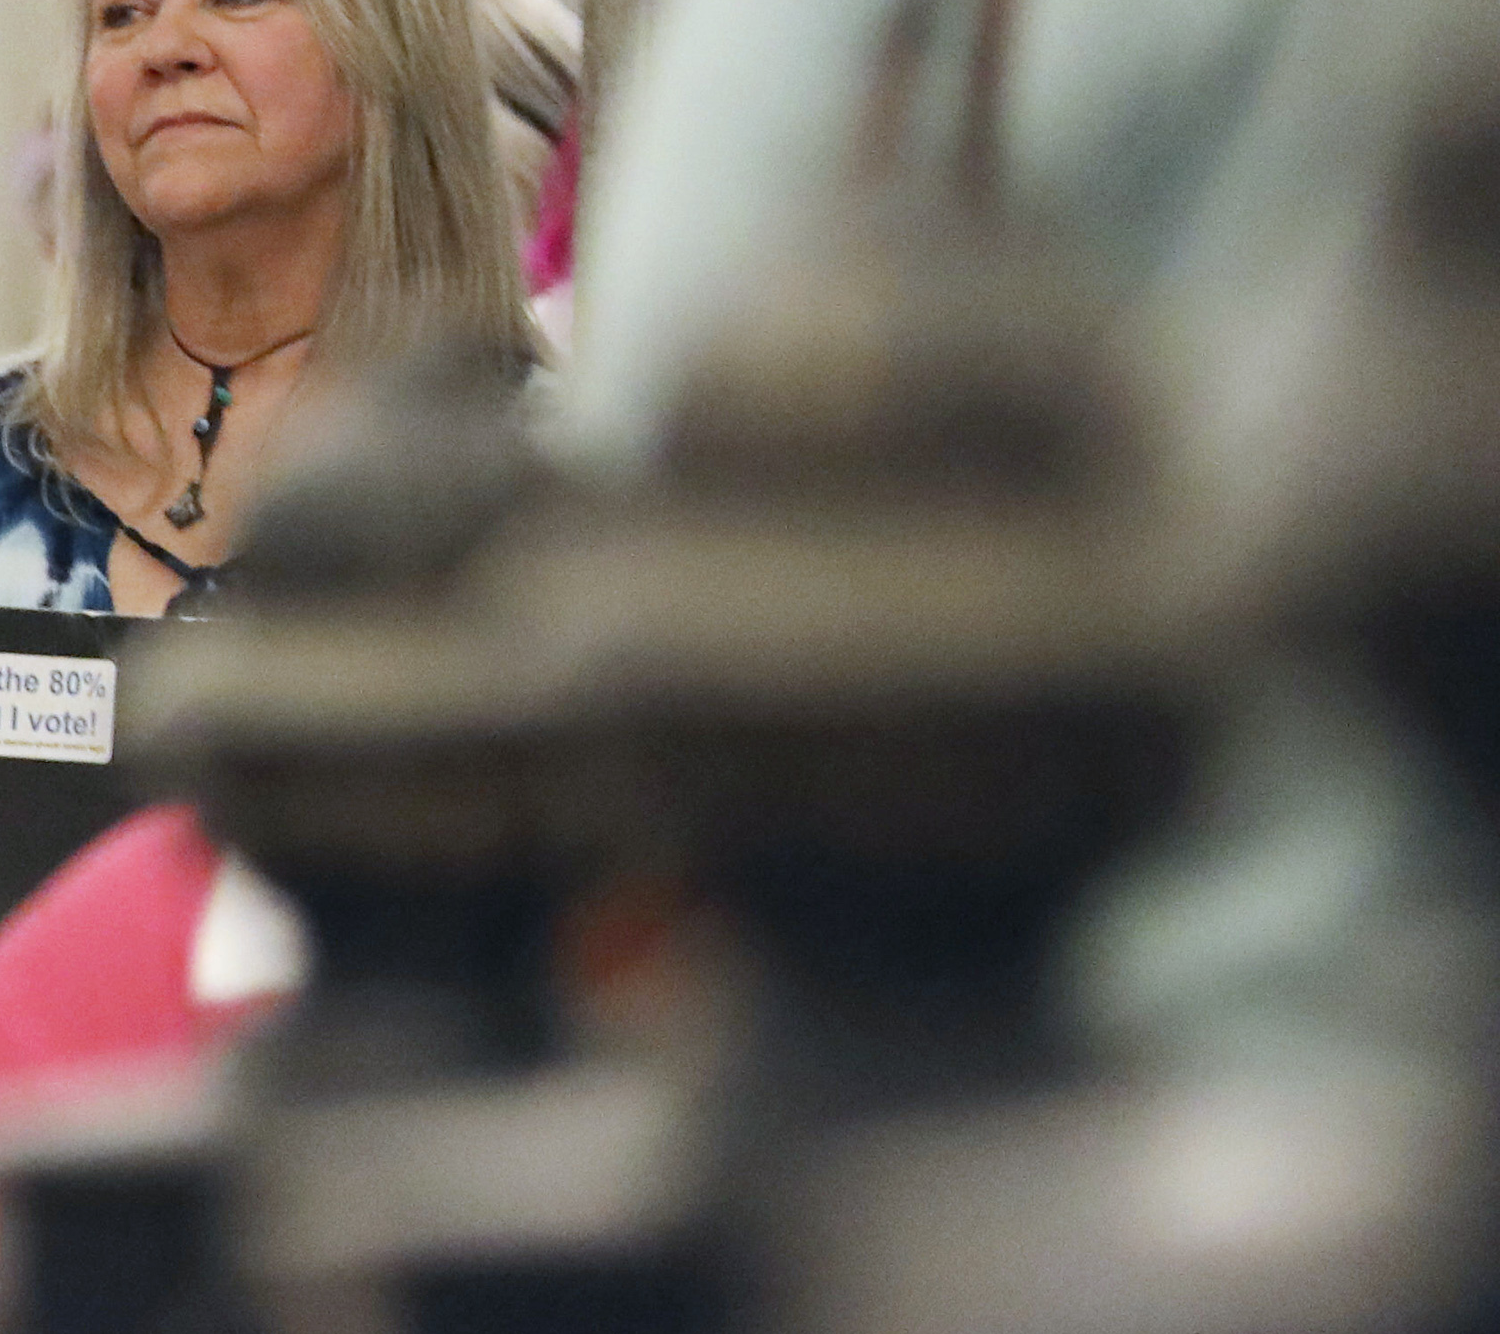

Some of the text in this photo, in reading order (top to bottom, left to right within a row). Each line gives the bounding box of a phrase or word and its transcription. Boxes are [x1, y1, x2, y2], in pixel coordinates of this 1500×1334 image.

[49, 669, 107, 699] 80%
[11, 706, 19, 731] I
[28, 712, 98, 738] vote!
